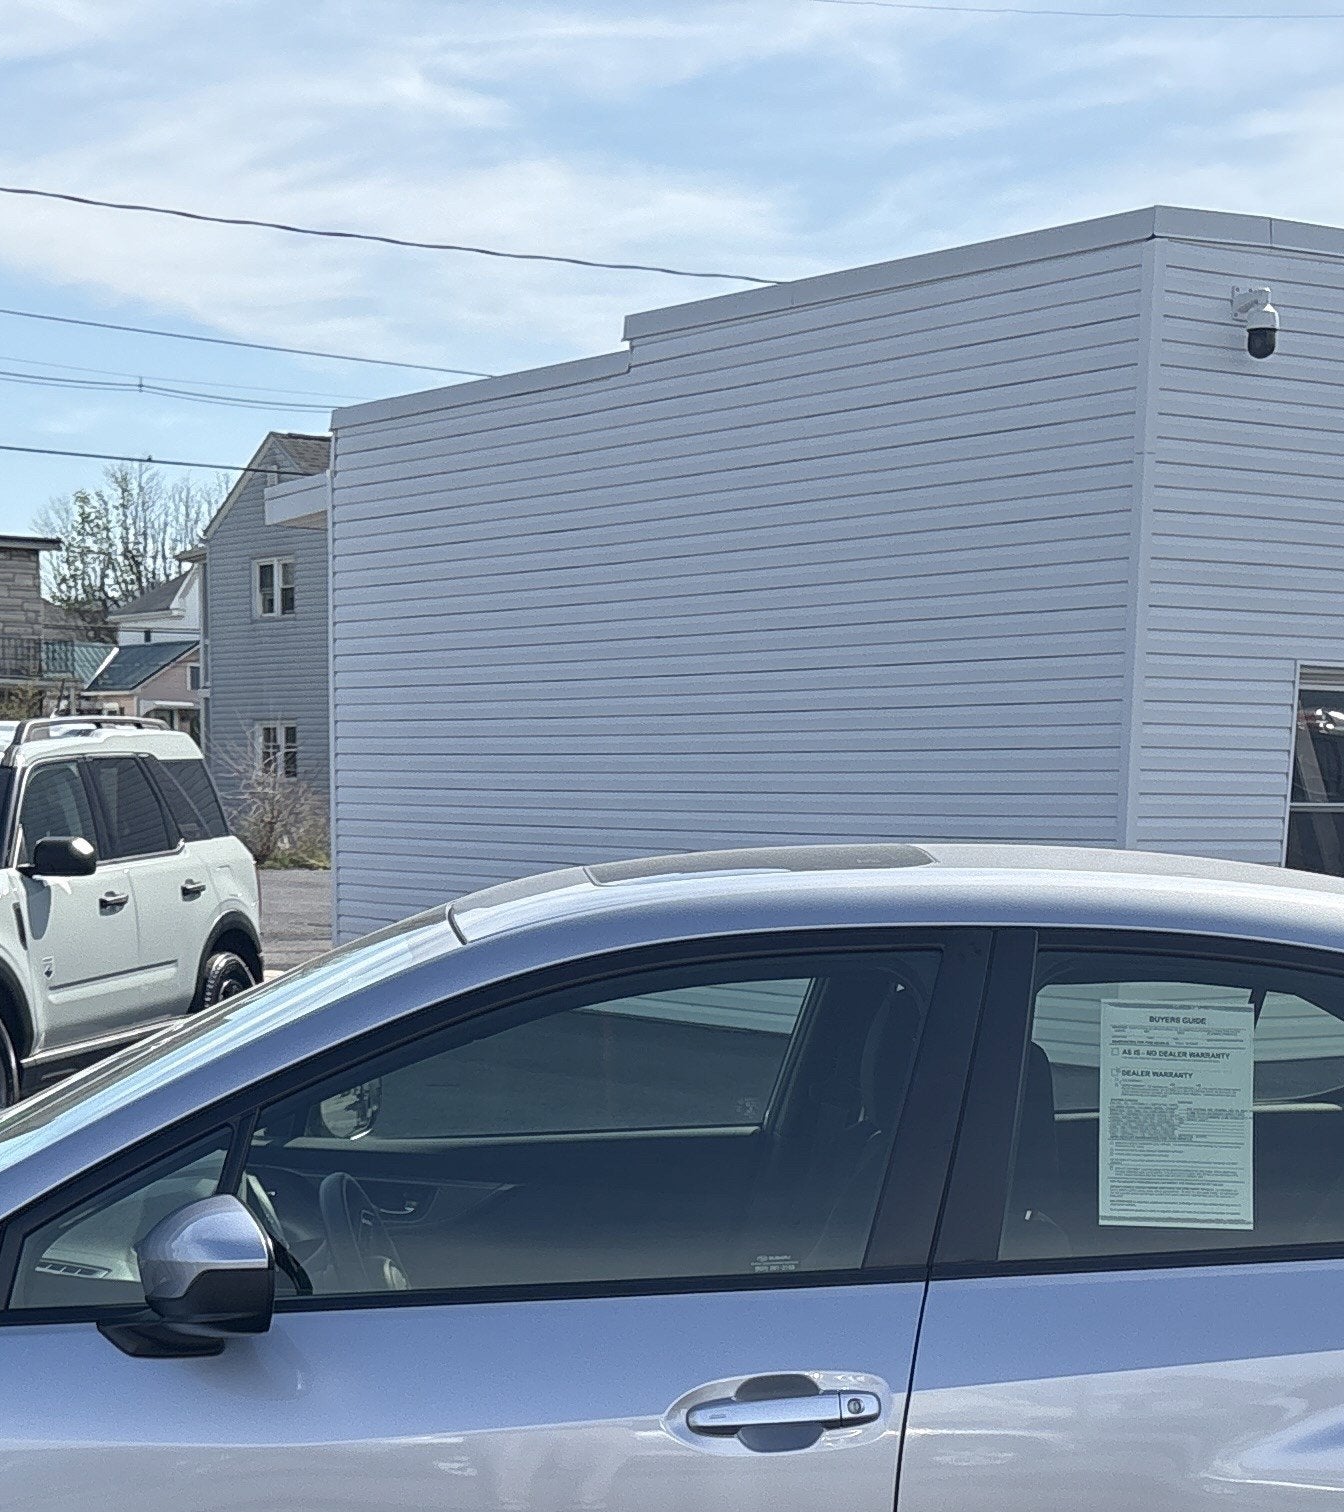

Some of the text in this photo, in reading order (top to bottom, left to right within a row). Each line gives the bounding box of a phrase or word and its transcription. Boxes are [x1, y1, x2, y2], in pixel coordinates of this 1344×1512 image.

[1149, 1016, 1207, 1025] BUYERS GUIDE
[1158, 1050, 1187, 1058] DEALER
[1189, 1052, 1230, 1060] WARRANTY
[1121, 1069, 1193, 1079] DEALER WARRANTY
